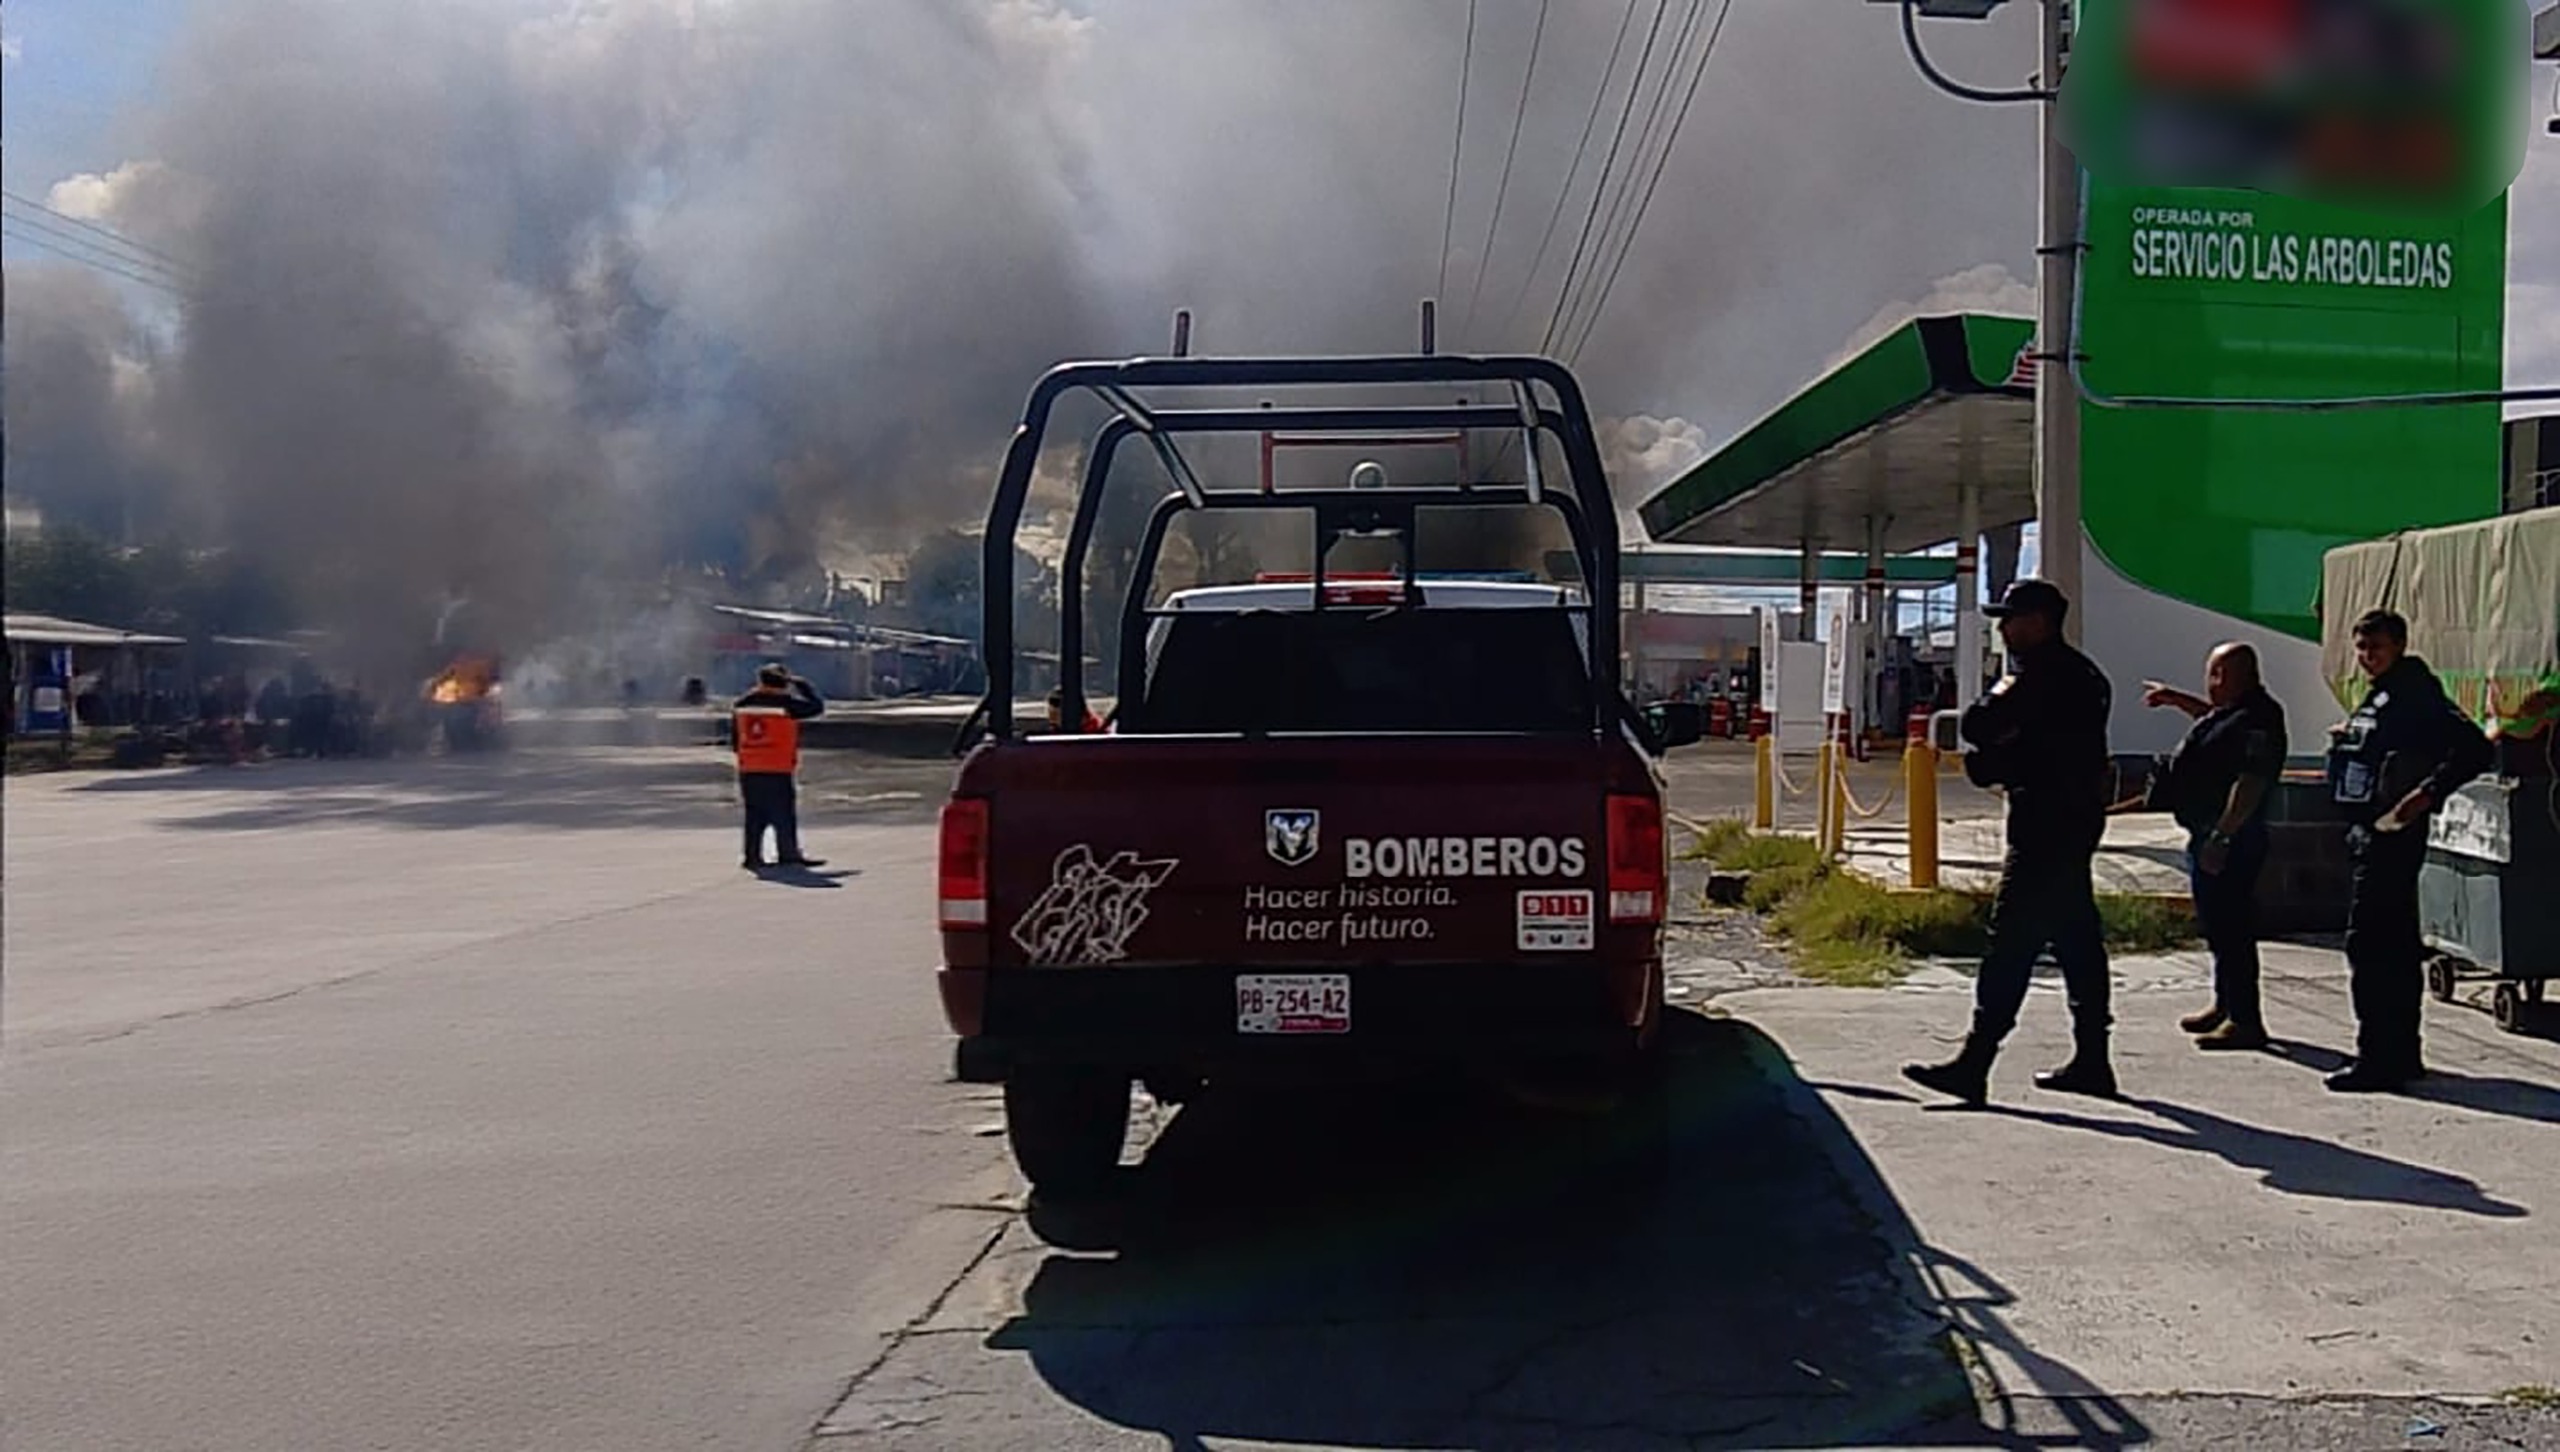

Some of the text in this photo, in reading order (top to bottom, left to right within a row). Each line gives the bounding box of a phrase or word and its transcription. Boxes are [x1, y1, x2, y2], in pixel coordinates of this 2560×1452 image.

[2133, 207, 2253, 228] OPERADA POR
[2133, 229, 2451, 288] SERVICIO LAS ARBOLEDAS
[1346, 837, 1586, 878] BOMBEROS
[1244, 880, 1458, 909] Hacer historia.
[1526, 898, 1583, 914] 911
[1245, 913, 1435, 947] Hacer futuro.
